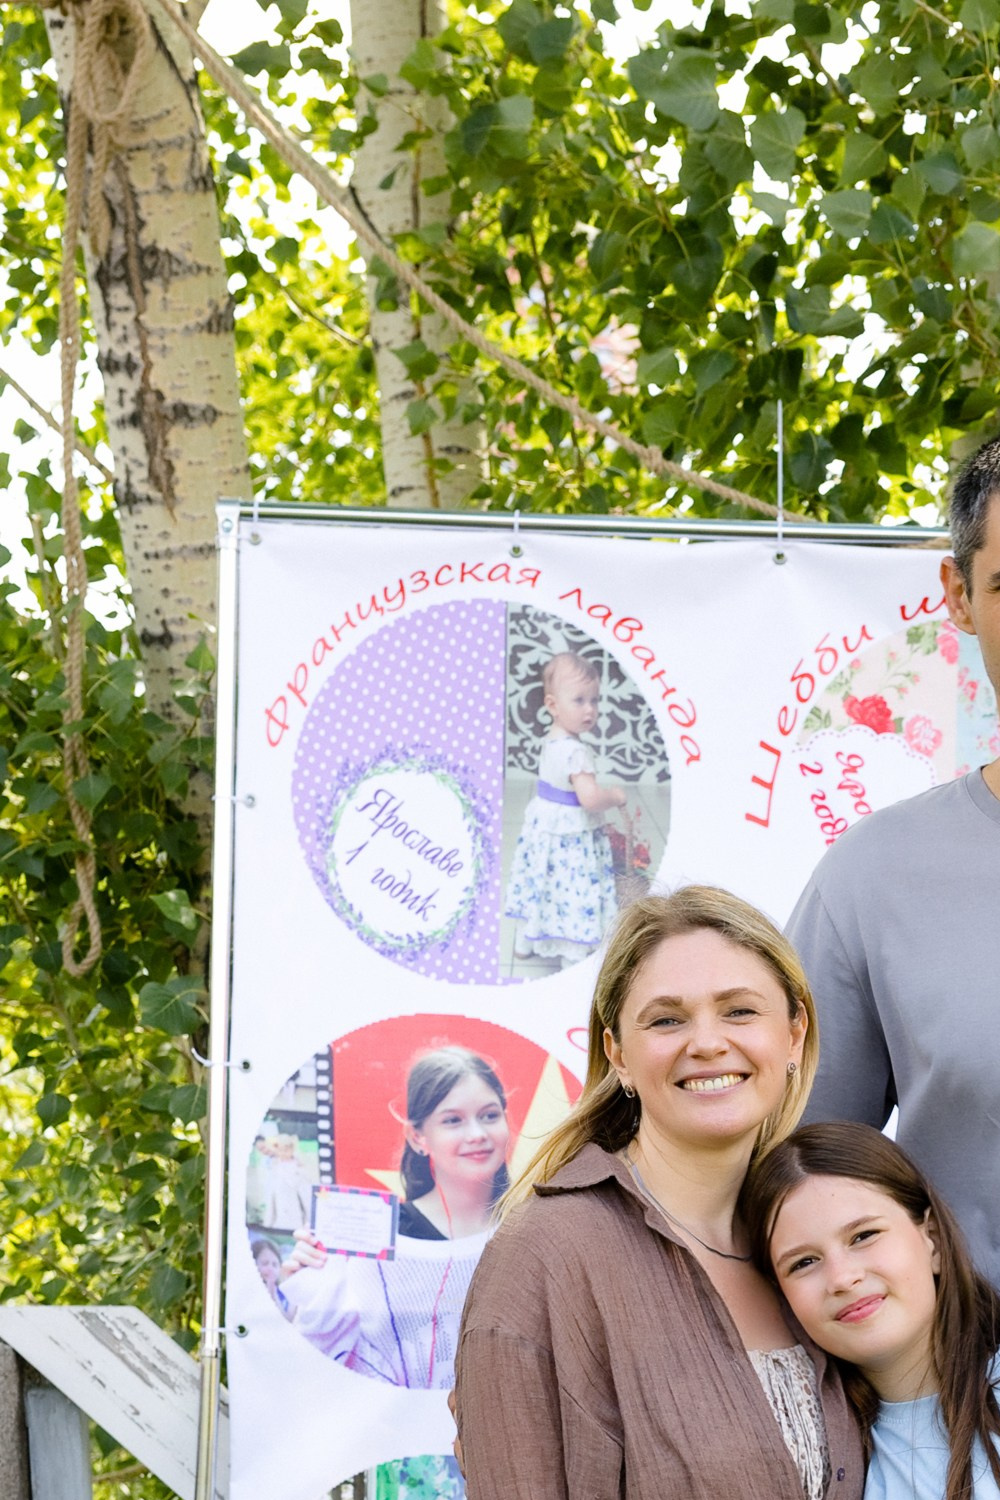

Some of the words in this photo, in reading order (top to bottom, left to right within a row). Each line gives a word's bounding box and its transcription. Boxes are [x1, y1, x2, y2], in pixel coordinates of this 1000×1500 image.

[559, 587, 702, 767] лаванда
[355, 787, 465, 879] Ярославе
[371, 867, 441, 922] годик
